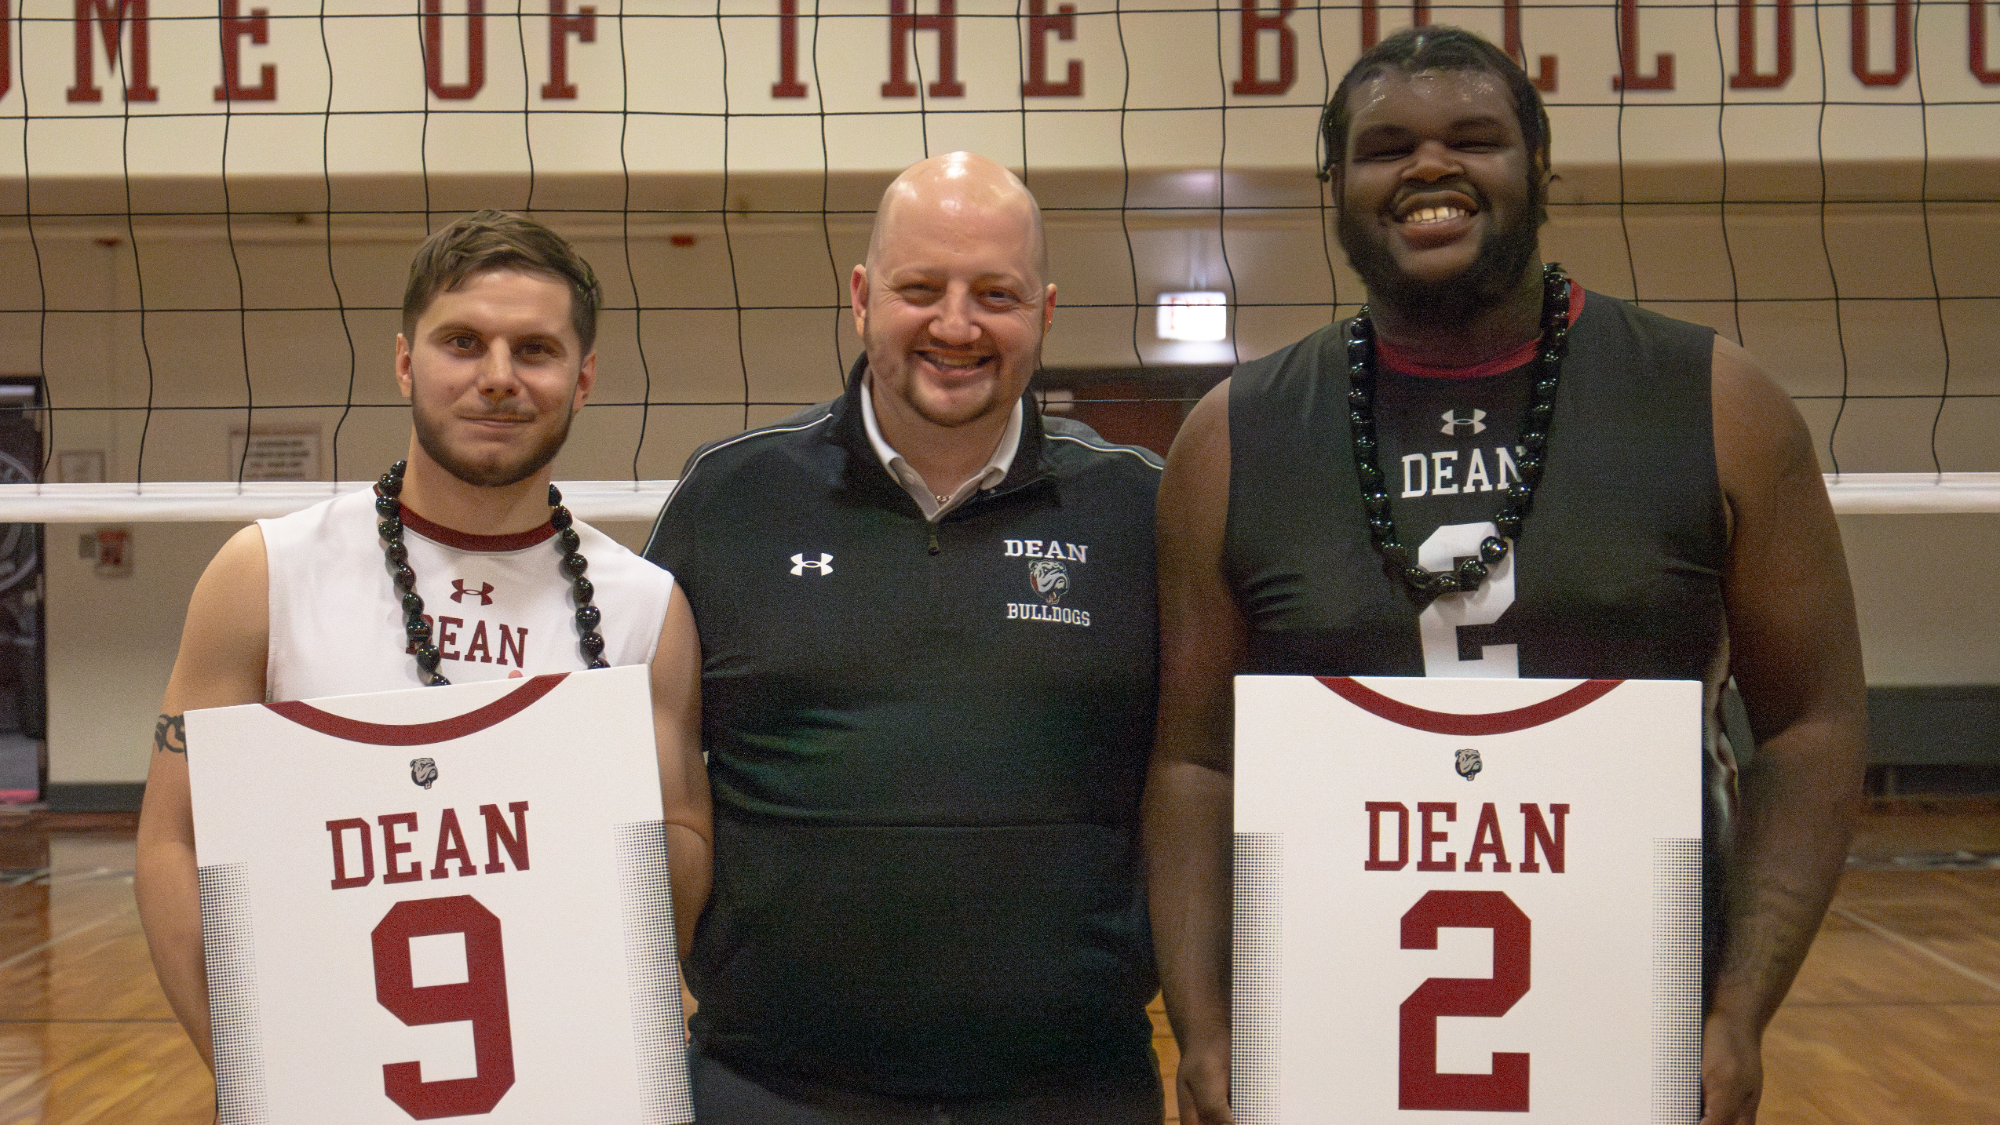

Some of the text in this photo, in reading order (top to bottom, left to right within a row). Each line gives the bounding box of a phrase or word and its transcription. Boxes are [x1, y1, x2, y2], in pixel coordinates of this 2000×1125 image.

[0, 0, 278, 103] ME
[1003, 539, 1089, 564] DEAN
[1417, 520, 1520, 679] 2
[1006, 602, 1091, 627] BULLDOGS
[326, 800, 531, 891] DEAN
[1364, 801, 1571, 874] DEAN
[371, 894, 516, 1121] 9
[1398, 889, 1532, 1113] 2
